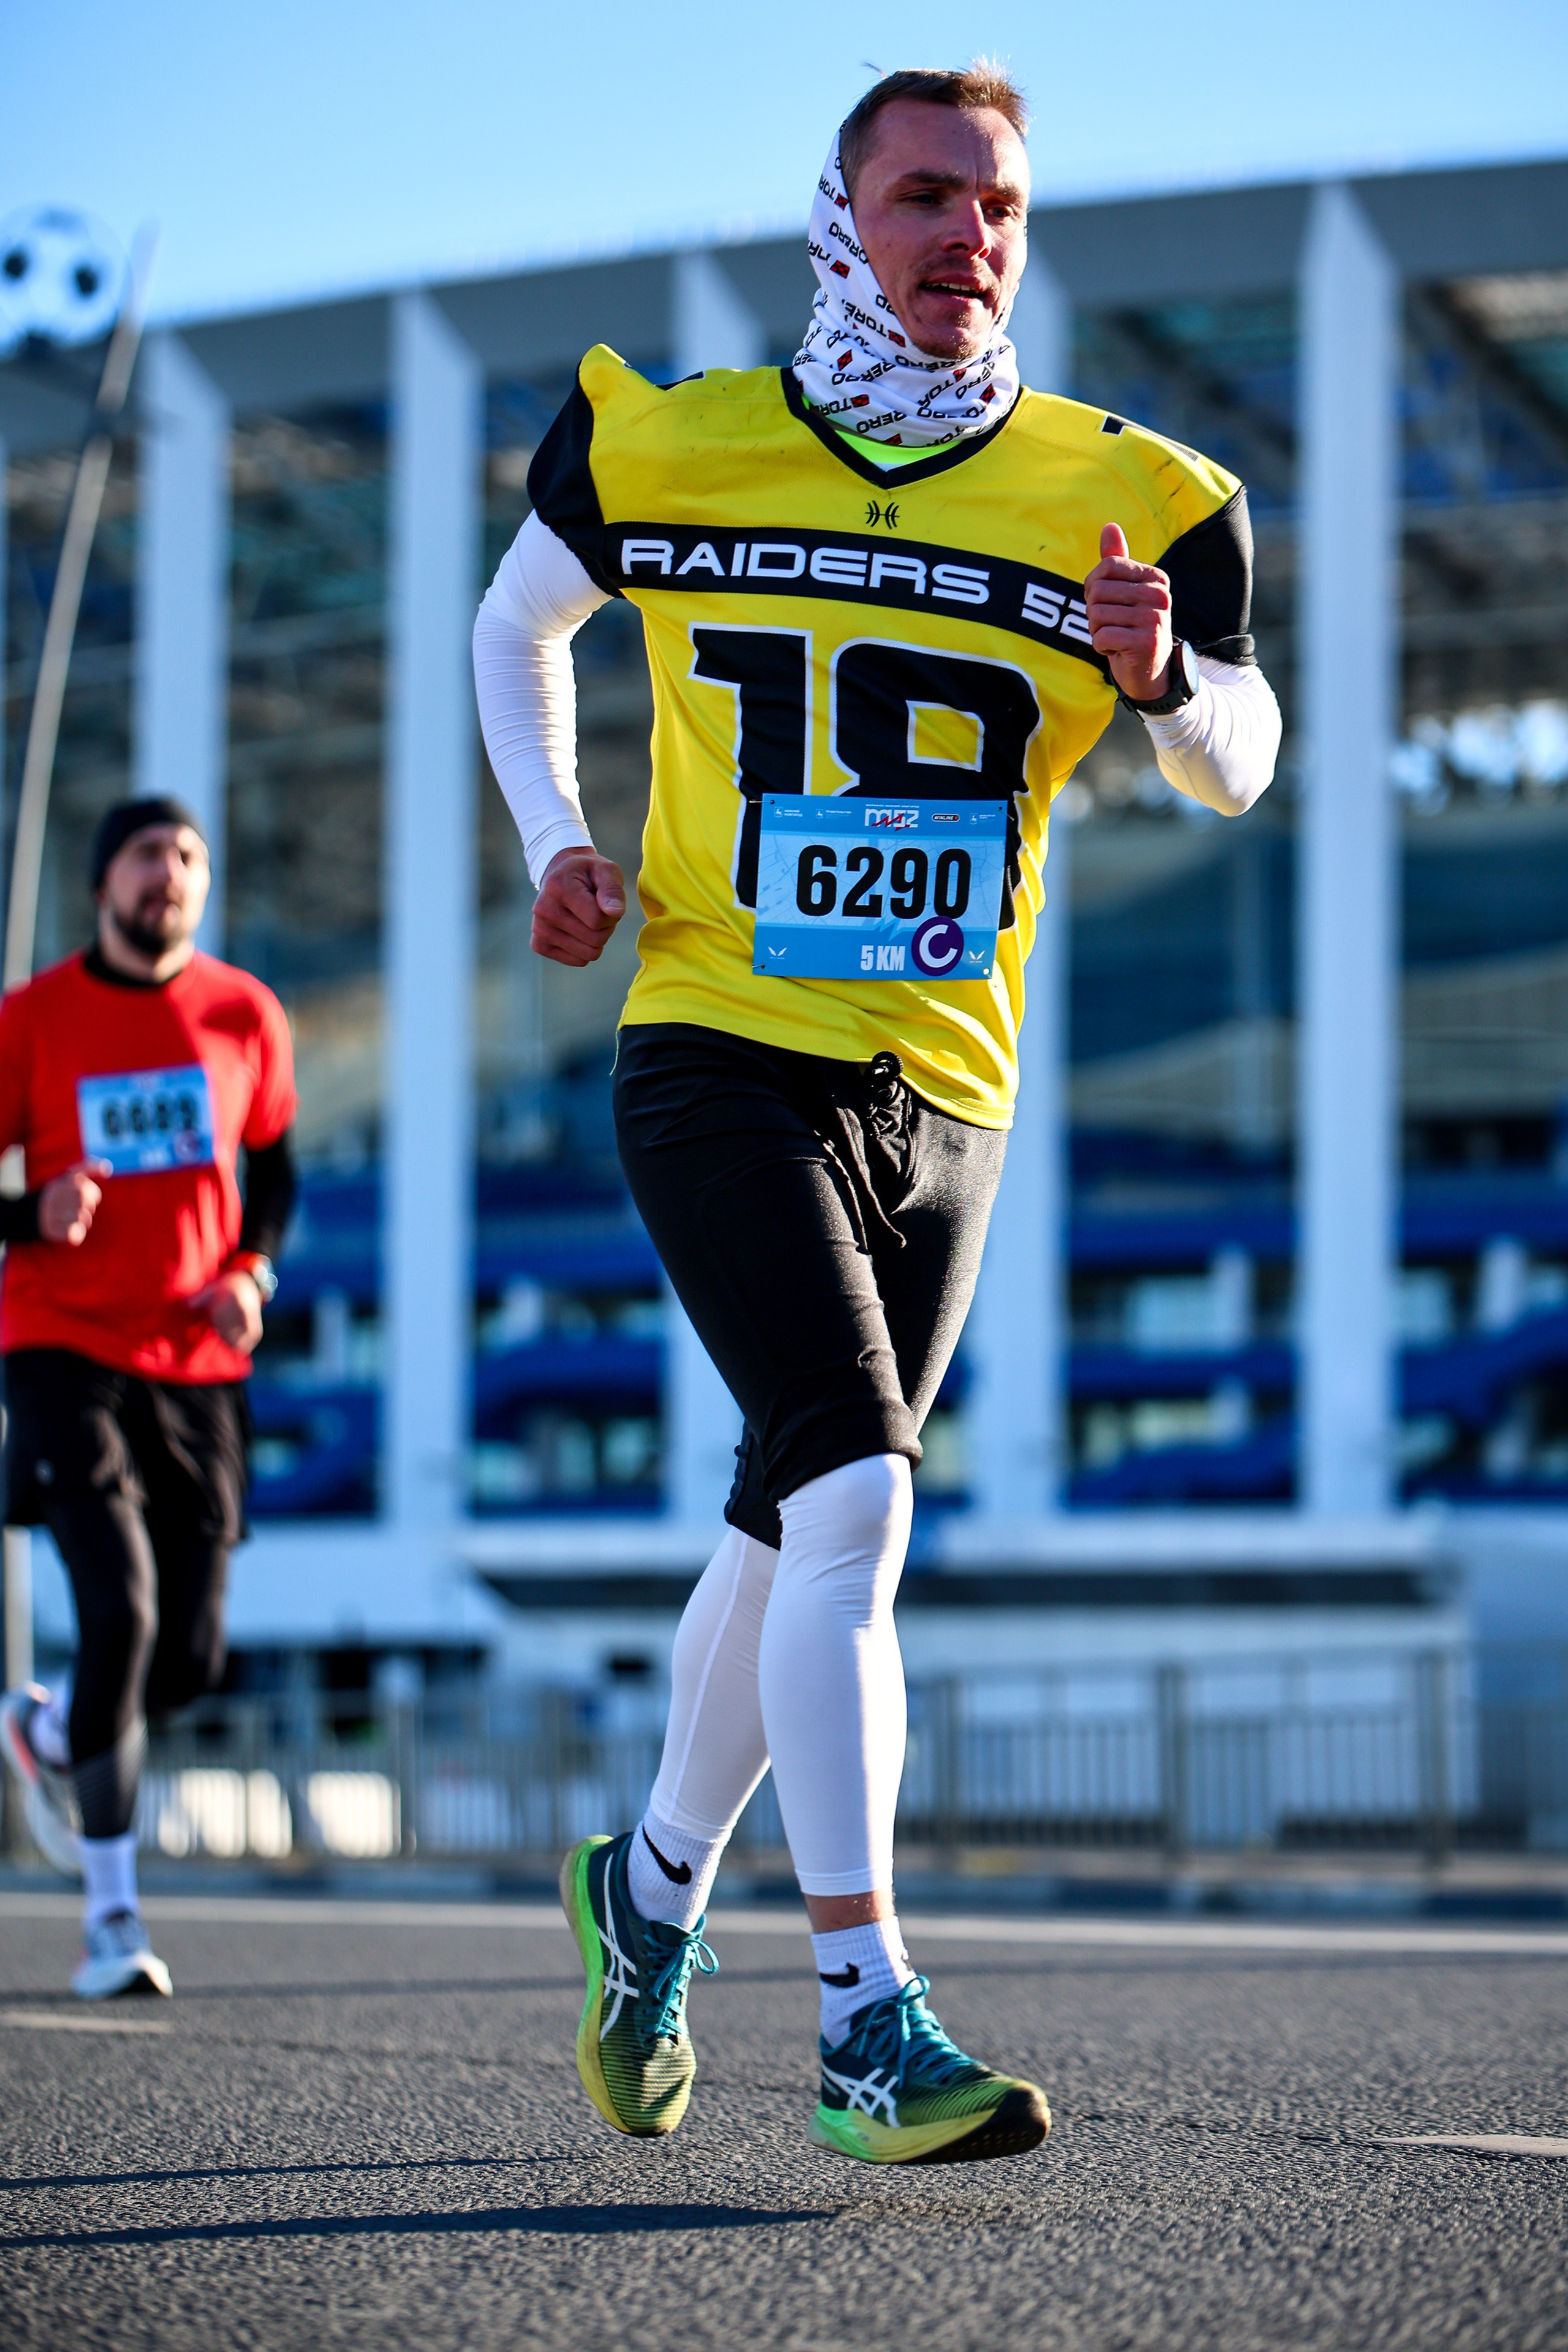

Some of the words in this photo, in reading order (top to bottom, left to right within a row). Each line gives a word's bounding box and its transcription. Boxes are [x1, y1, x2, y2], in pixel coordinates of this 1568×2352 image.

[620, 538, 990, 605] RAIDERS
[1021, 582, 1093, 646] 52
[687, 620, 1043, 933] 18
[796, 845, 971, 919] 6290
[860, 945, 874, 971] 5
[876, 946, 906, 971] KM
